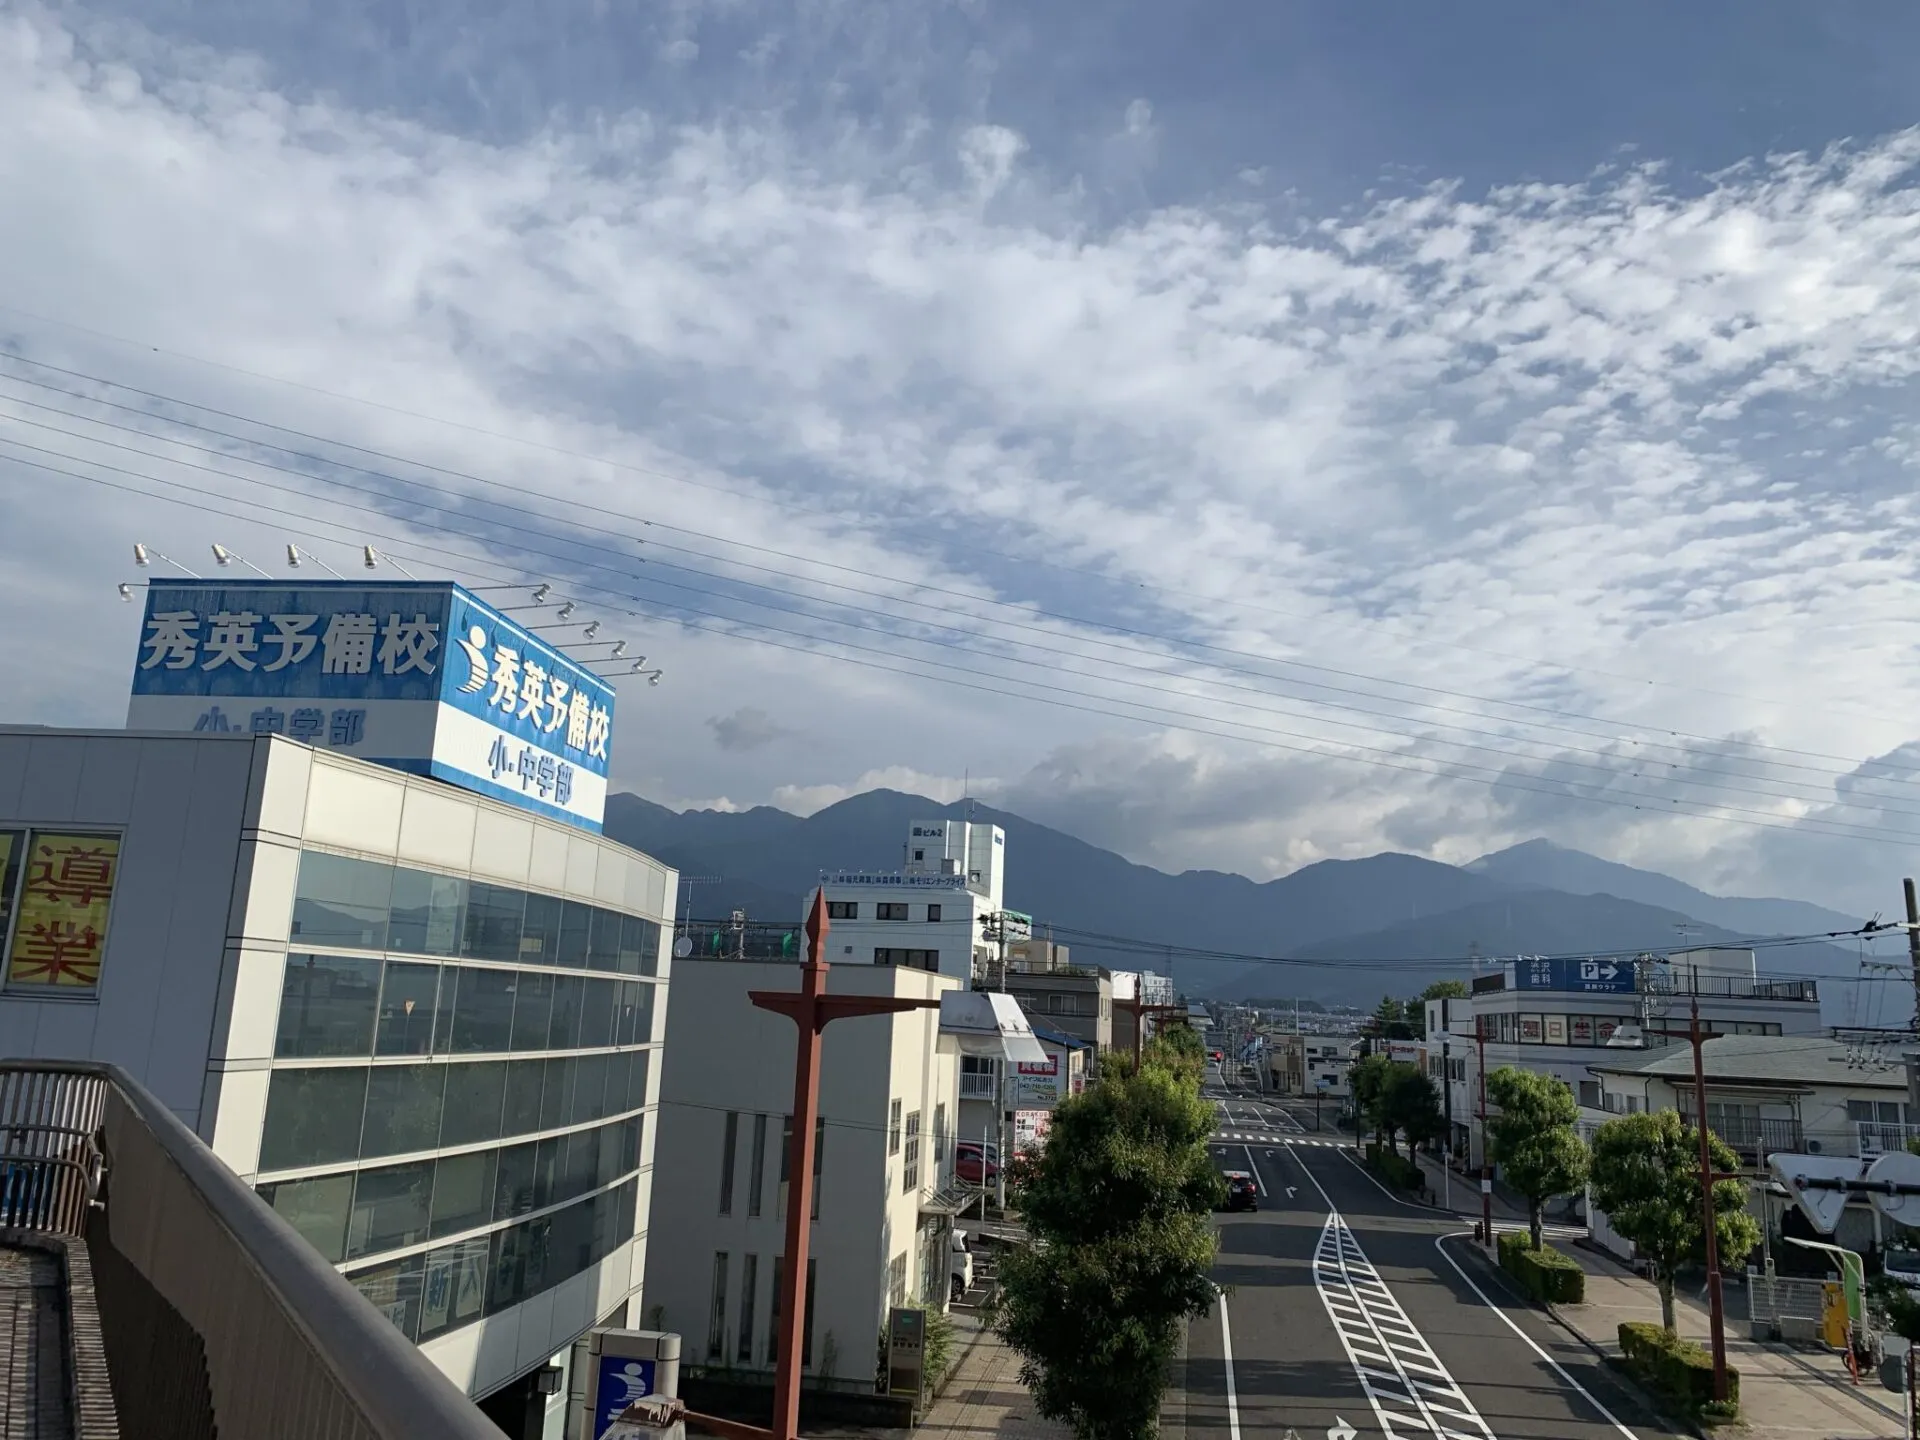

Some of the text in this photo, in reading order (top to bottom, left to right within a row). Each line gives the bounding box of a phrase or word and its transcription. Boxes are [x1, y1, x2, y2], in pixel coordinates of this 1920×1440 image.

[140, 610, 439, 676] 秀英予備校
[488, 644, 611, 762] 秀英予備校
[1530, 974, 1552, 985] 歯科
